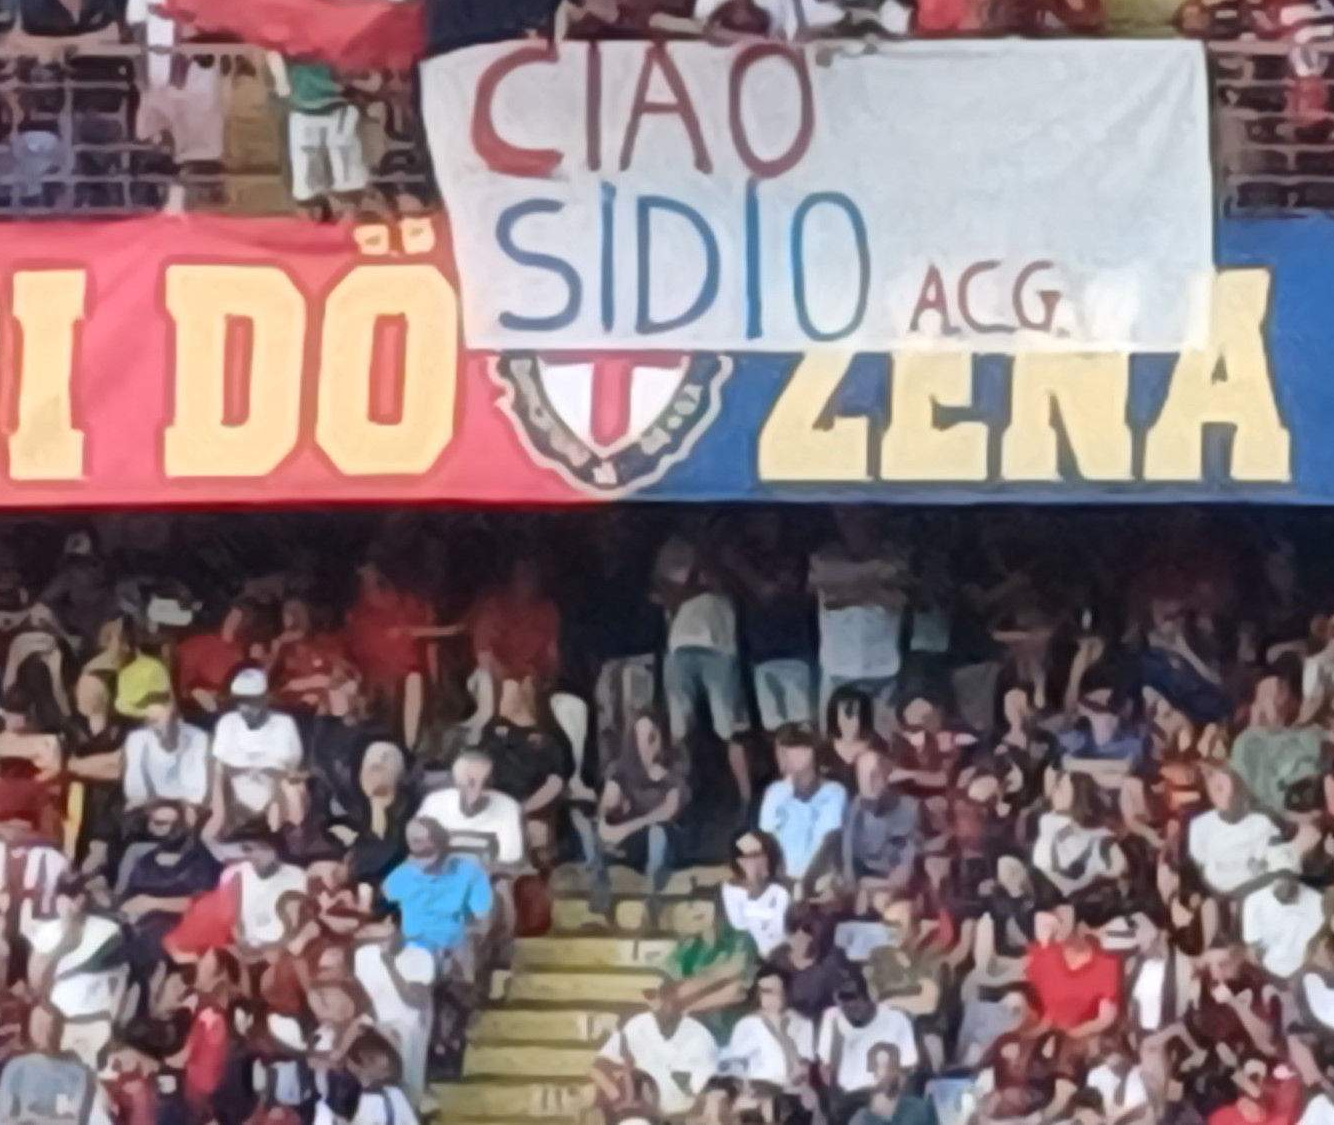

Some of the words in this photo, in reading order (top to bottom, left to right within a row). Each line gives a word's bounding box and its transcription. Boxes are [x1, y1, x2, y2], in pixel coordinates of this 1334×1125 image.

[470, 41, 816, 179] CIAO
[494, 180, 871, 342] SIDIO
[758, 267, 1292, 483] ZENA
